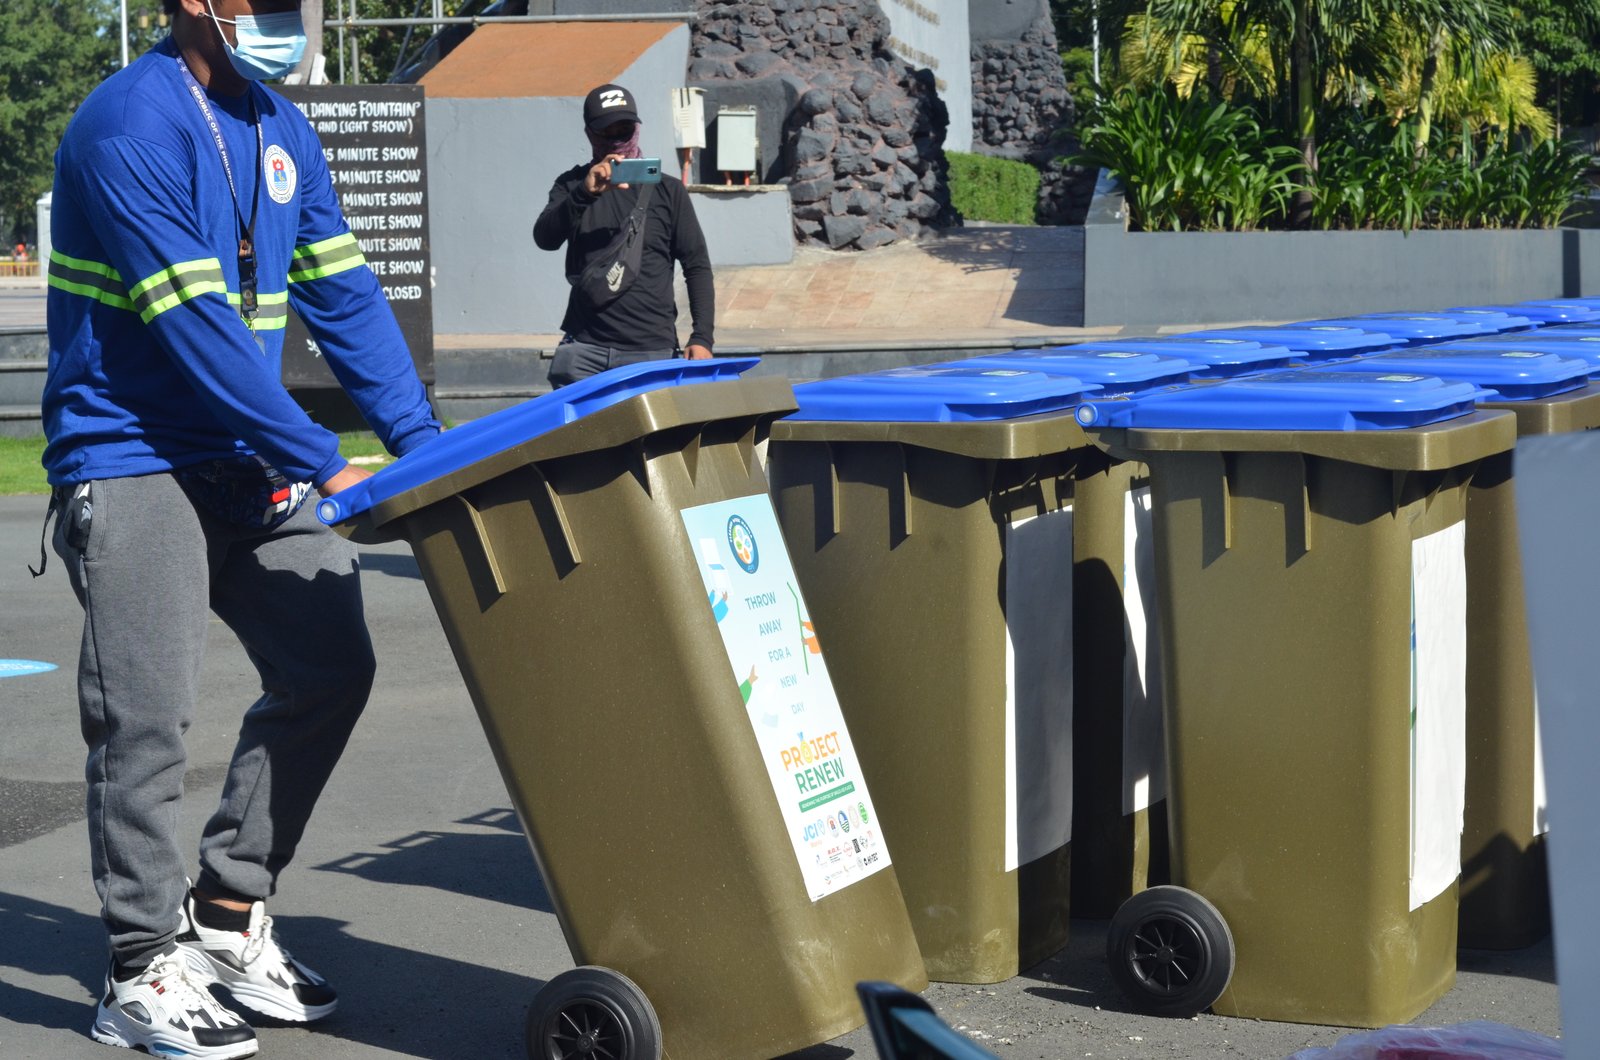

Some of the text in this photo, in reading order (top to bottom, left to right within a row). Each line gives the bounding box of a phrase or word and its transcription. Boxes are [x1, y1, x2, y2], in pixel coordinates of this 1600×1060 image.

[191, 86, 213, 120] REPUBLIC
[210, 122, 219, 133] OF
[216, 134, 224, 150] THE
[311, 102, 357, 118] DANCING
[318, 121, 338, 132] AND
[340, 121, 370, 134] LIGHT
[372, 118, 413, 134] SHOW)
[337, 148, 379, 162] MINUTE
[382, 147, 418, 162] SHOW
[339, 170, 383, 184] MINUTE
[385, 169, 421, 184] SHOW
[342, 192, 423, 206] MINUTE SHOW
[388, 214, 422, 229] SHOW
[358, 236, 422, 252] NUTE SHOW
[388, 260, 424, 275] SHOW
[606, 261, 621, 284] NIKE
[382, 286, 422, 300] CLOSED
[744, 592, 777, 610] THROW
[758, 618, 782, 636] AWAY
[768, 647, 792, 662] FOR A
[780, 674, 798, 688] NEW
[791, 702, 805, 714] DAY
[780, 731, 841, 772] PROJECT
[794, 756, 845, 794] RENEW
[803, 820, 819, 842] JCI
